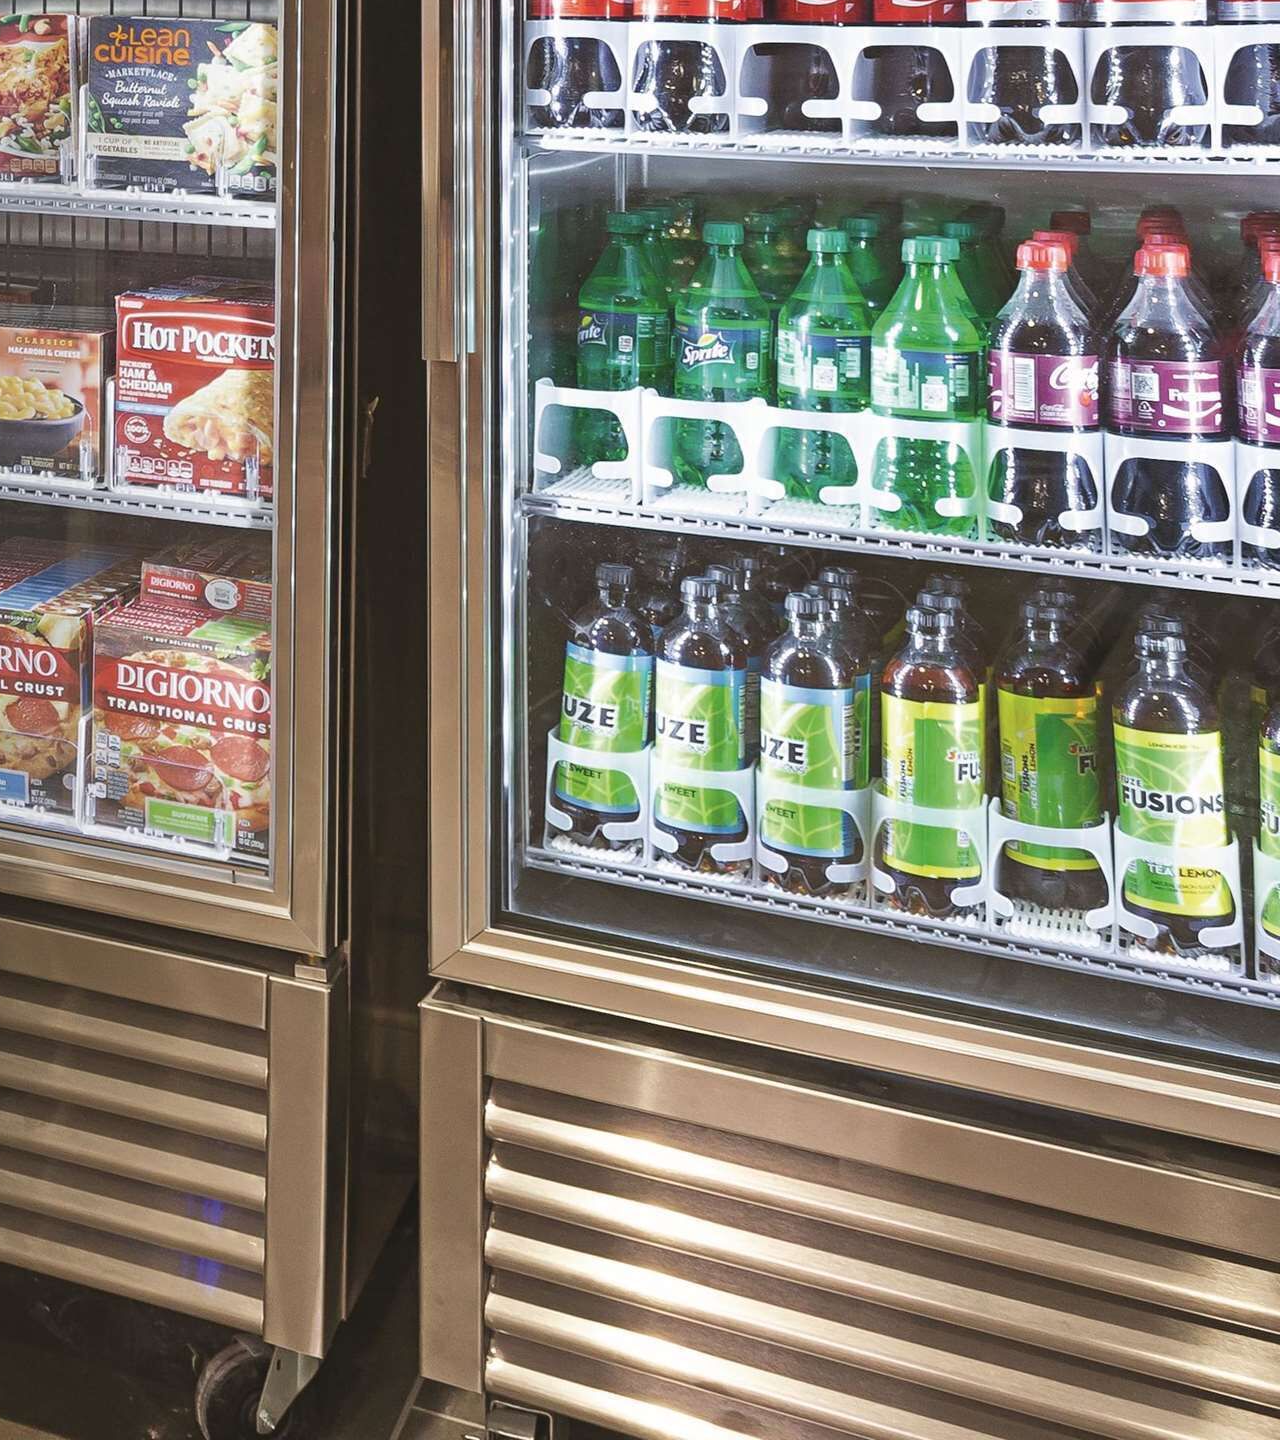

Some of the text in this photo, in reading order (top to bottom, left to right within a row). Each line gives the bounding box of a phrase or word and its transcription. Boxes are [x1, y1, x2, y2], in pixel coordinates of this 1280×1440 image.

[107, 67, 174, 81] MARKETPLACE
[115, 80, 167, 96] Butternut
[101, 92, 181, 109] Squash Ravioli
[131, 320, 276, 362] HOT POCKETS
[8, 347, 81, 358] MACARONI CHEESE
[682, 342, 729, 365] Sprite
[120, 368, 157, 381] HAM &
[119, 379, 172, 394] CHEDDAR
[14, 681, 65, 697] CRUST
[116, 663, 270, 714] DIGIORNO
[107, 696, 217, 726] TRADITIONAL
[569, 762, 603, 780] SWEET
[1122, 787, 1224, 814] FUSIONS
[1148, 862, 1221, 878] TEA LEMON
